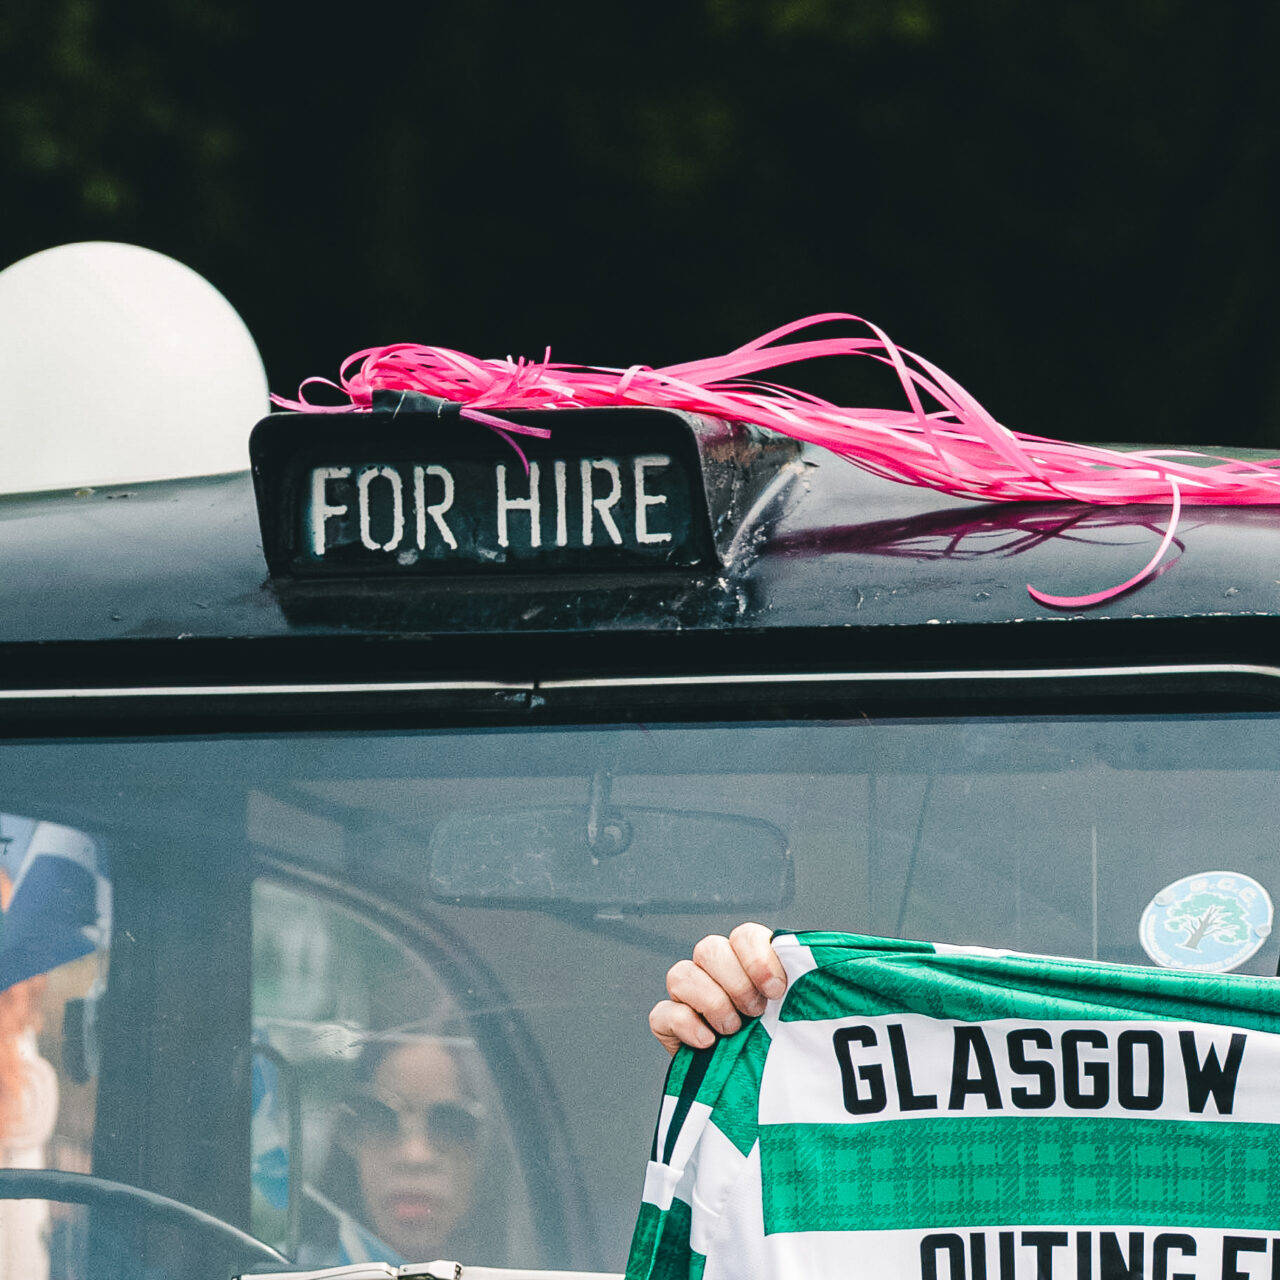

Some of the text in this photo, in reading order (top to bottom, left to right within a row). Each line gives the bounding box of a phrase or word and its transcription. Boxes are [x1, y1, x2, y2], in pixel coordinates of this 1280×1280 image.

[310, 455, 673, 556] FOR HIRE
[831, 1023, 1248, 1116] GLASGOW
